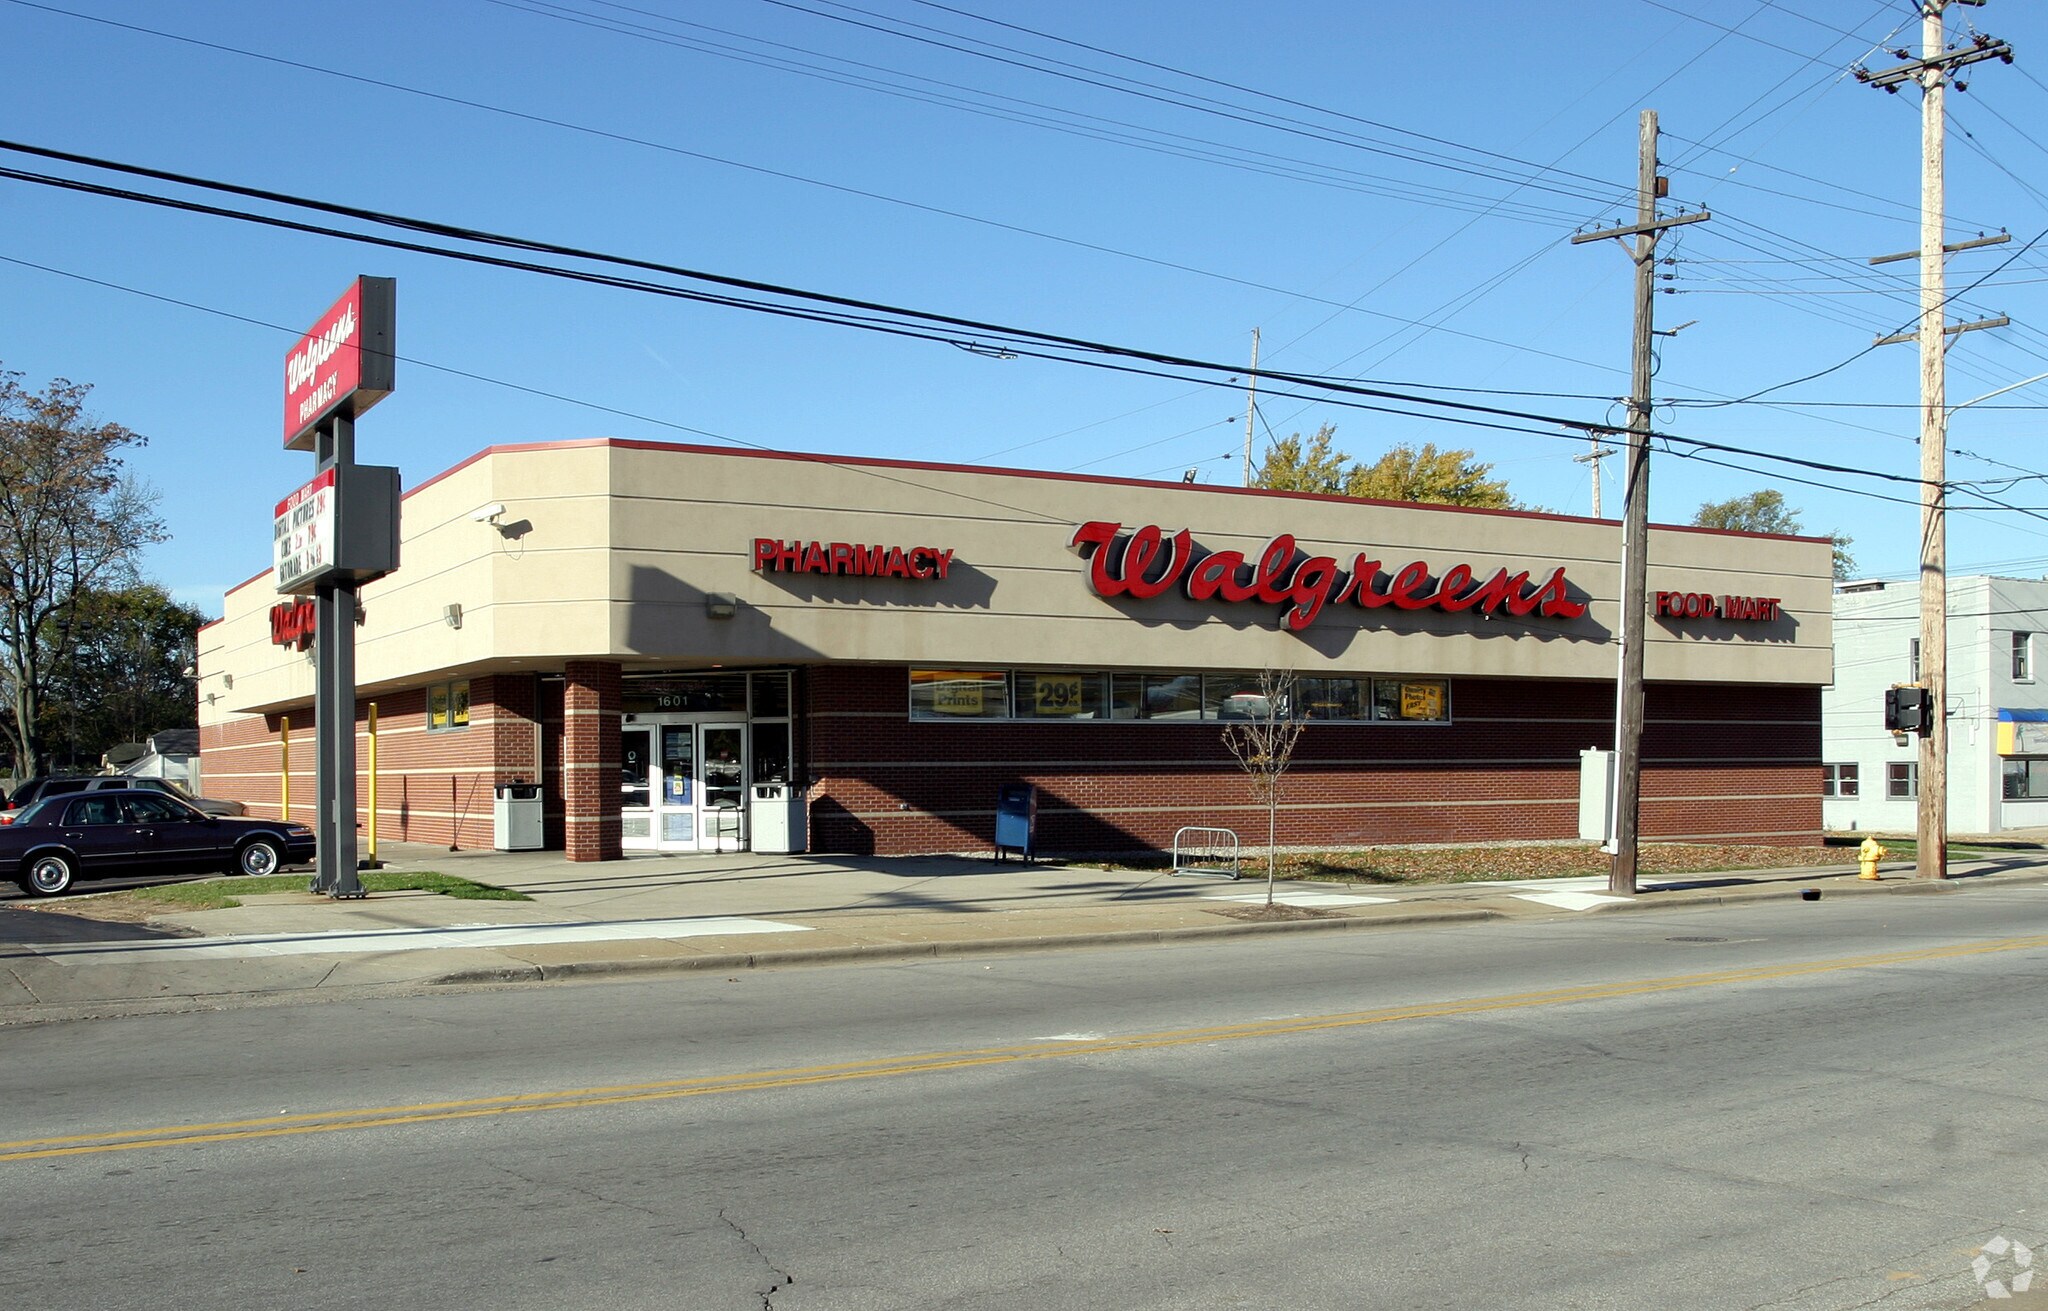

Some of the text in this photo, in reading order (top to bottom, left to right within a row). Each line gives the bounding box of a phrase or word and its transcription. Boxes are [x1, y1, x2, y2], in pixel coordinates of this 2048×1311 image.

[288, 302, 357, 395] Walgreens
[299, 370, 338, 424] PHARMACY
[287, 483, 313, 510] FOOD MART
[752, 538, 955, 579] PHARMACY
[1066, 521, 1588, 631] Walgreens
[1653, 591, 1782, 621] FOOD MART
[658, 695, 688, 706] 1601
[937, 690, 979, 706] Prints
[1038, 681, 1079, 708] 29¢
